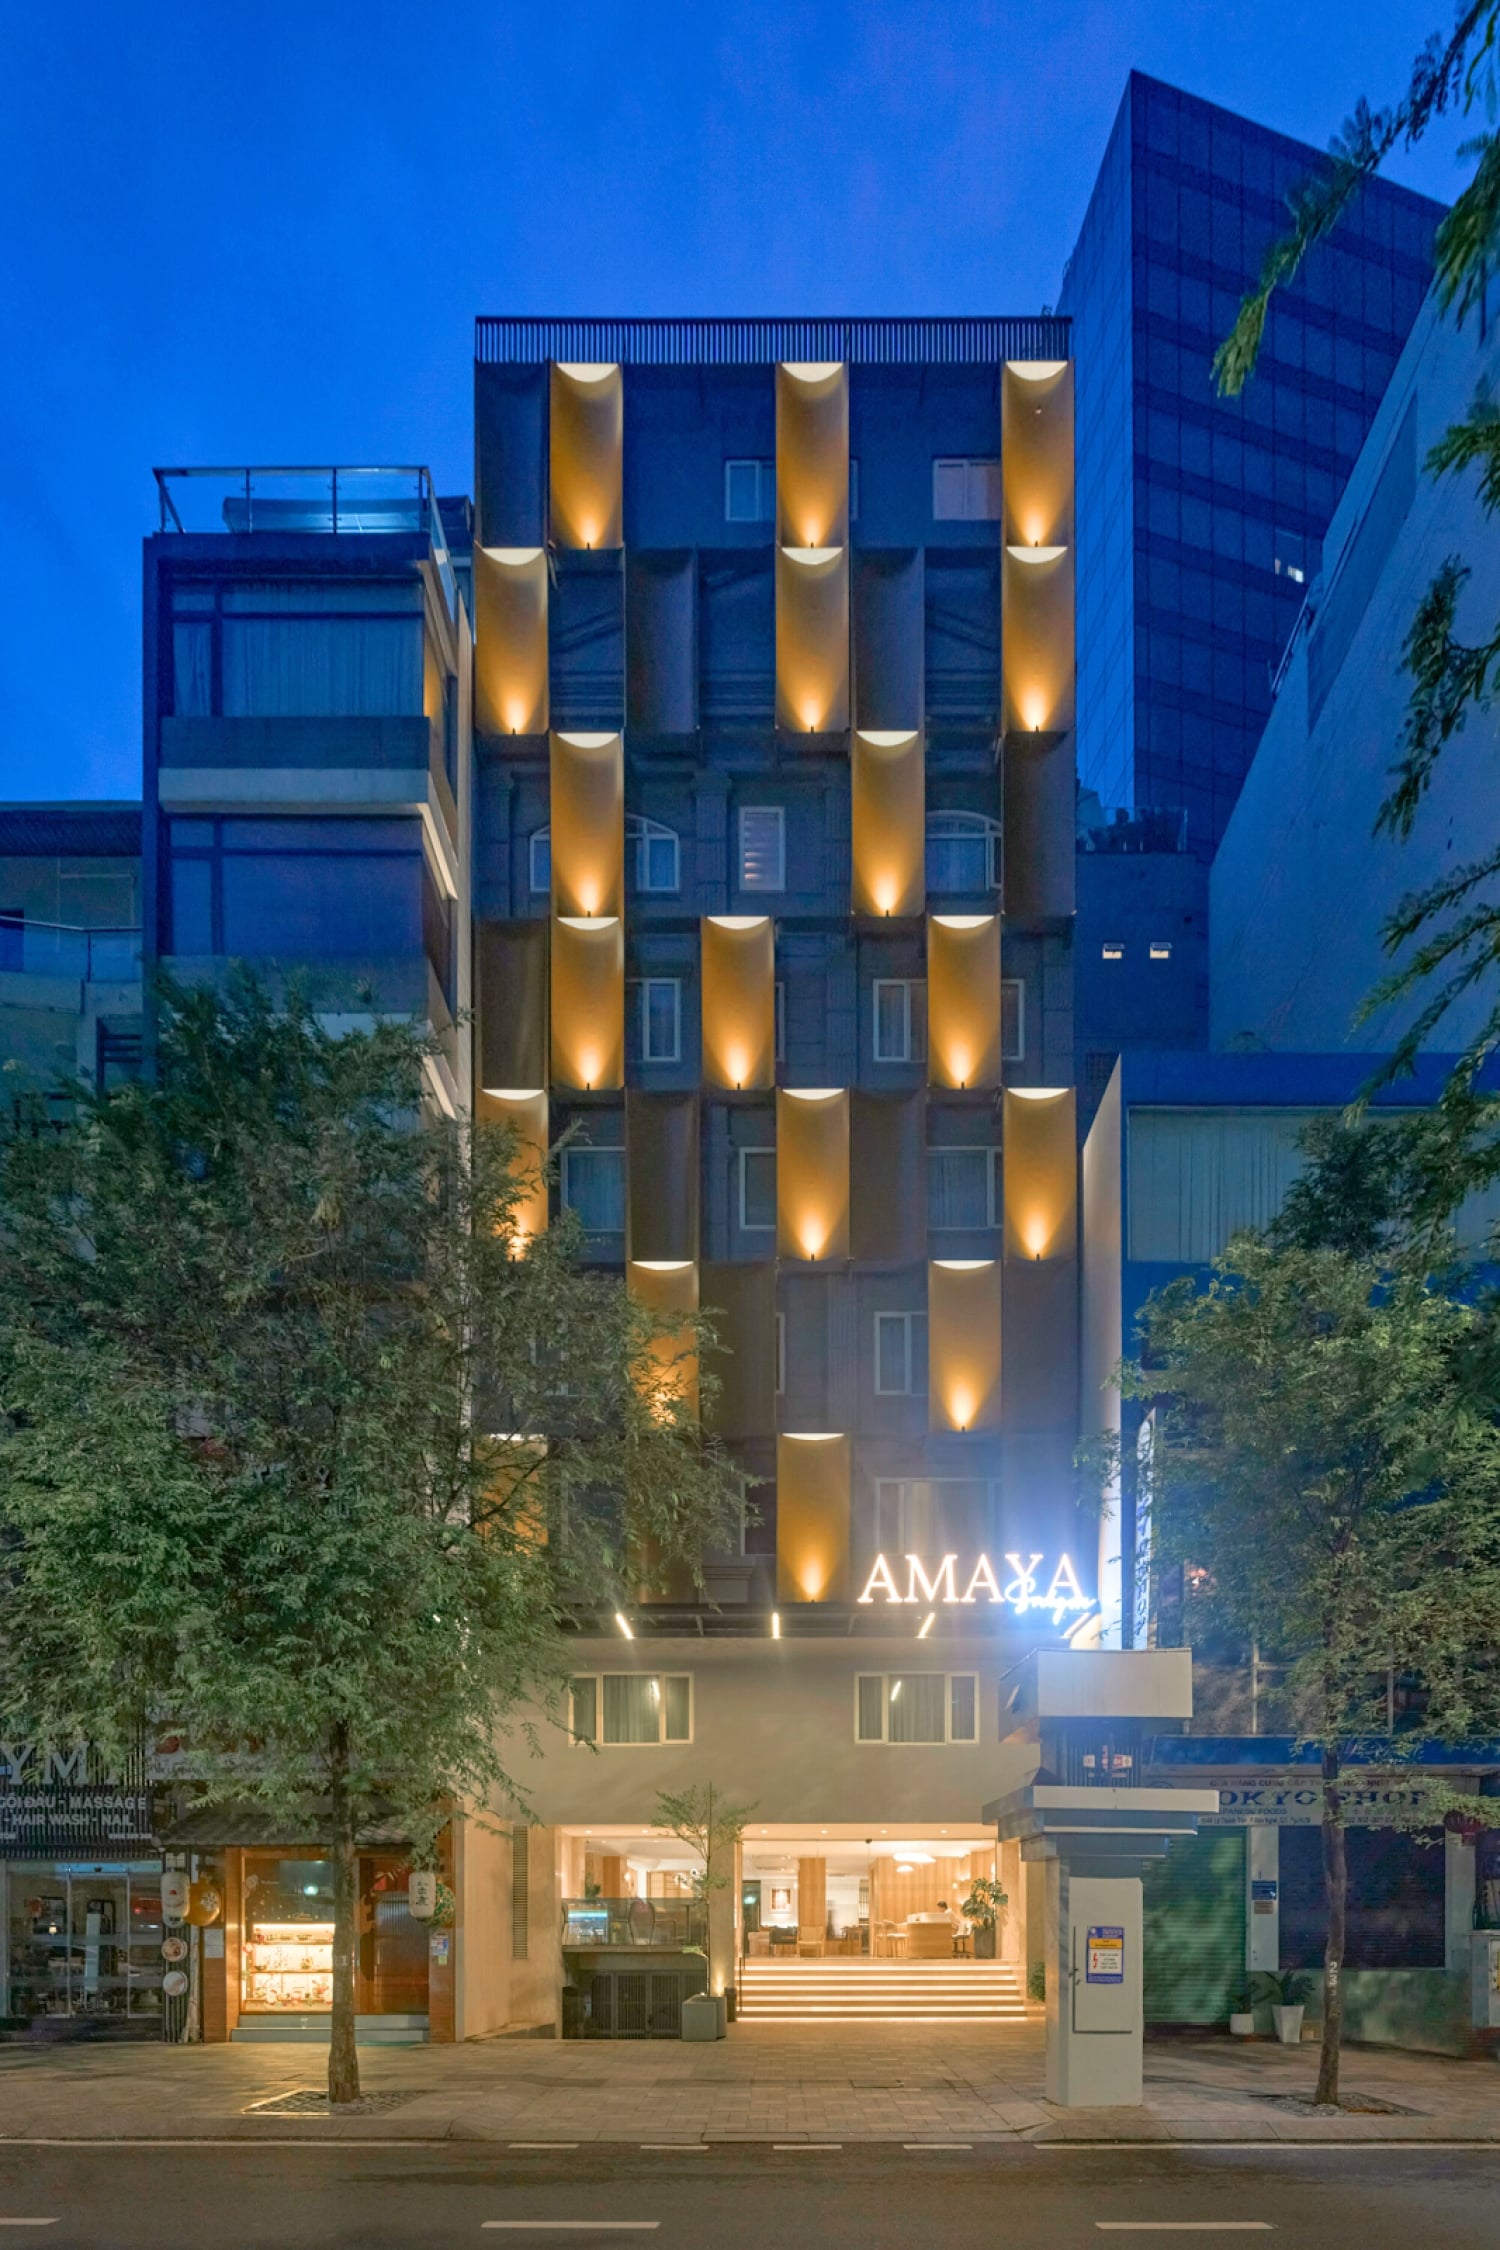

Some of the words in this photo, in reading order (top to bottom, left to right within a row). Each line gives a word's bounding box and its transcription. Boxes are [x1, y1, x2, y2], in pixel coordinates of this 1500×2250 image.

[857, 1552, 1085, 1604] AMAYA
[69, 1795, 147, 1810] MASSAGE
[1219, 1790, 1318, 1806] OKYO
[12, 1813, 46, 1826] HAIR
[49, 1813, 89, 1826] WASH
[101, 1814, 133, 1826] NAIL
